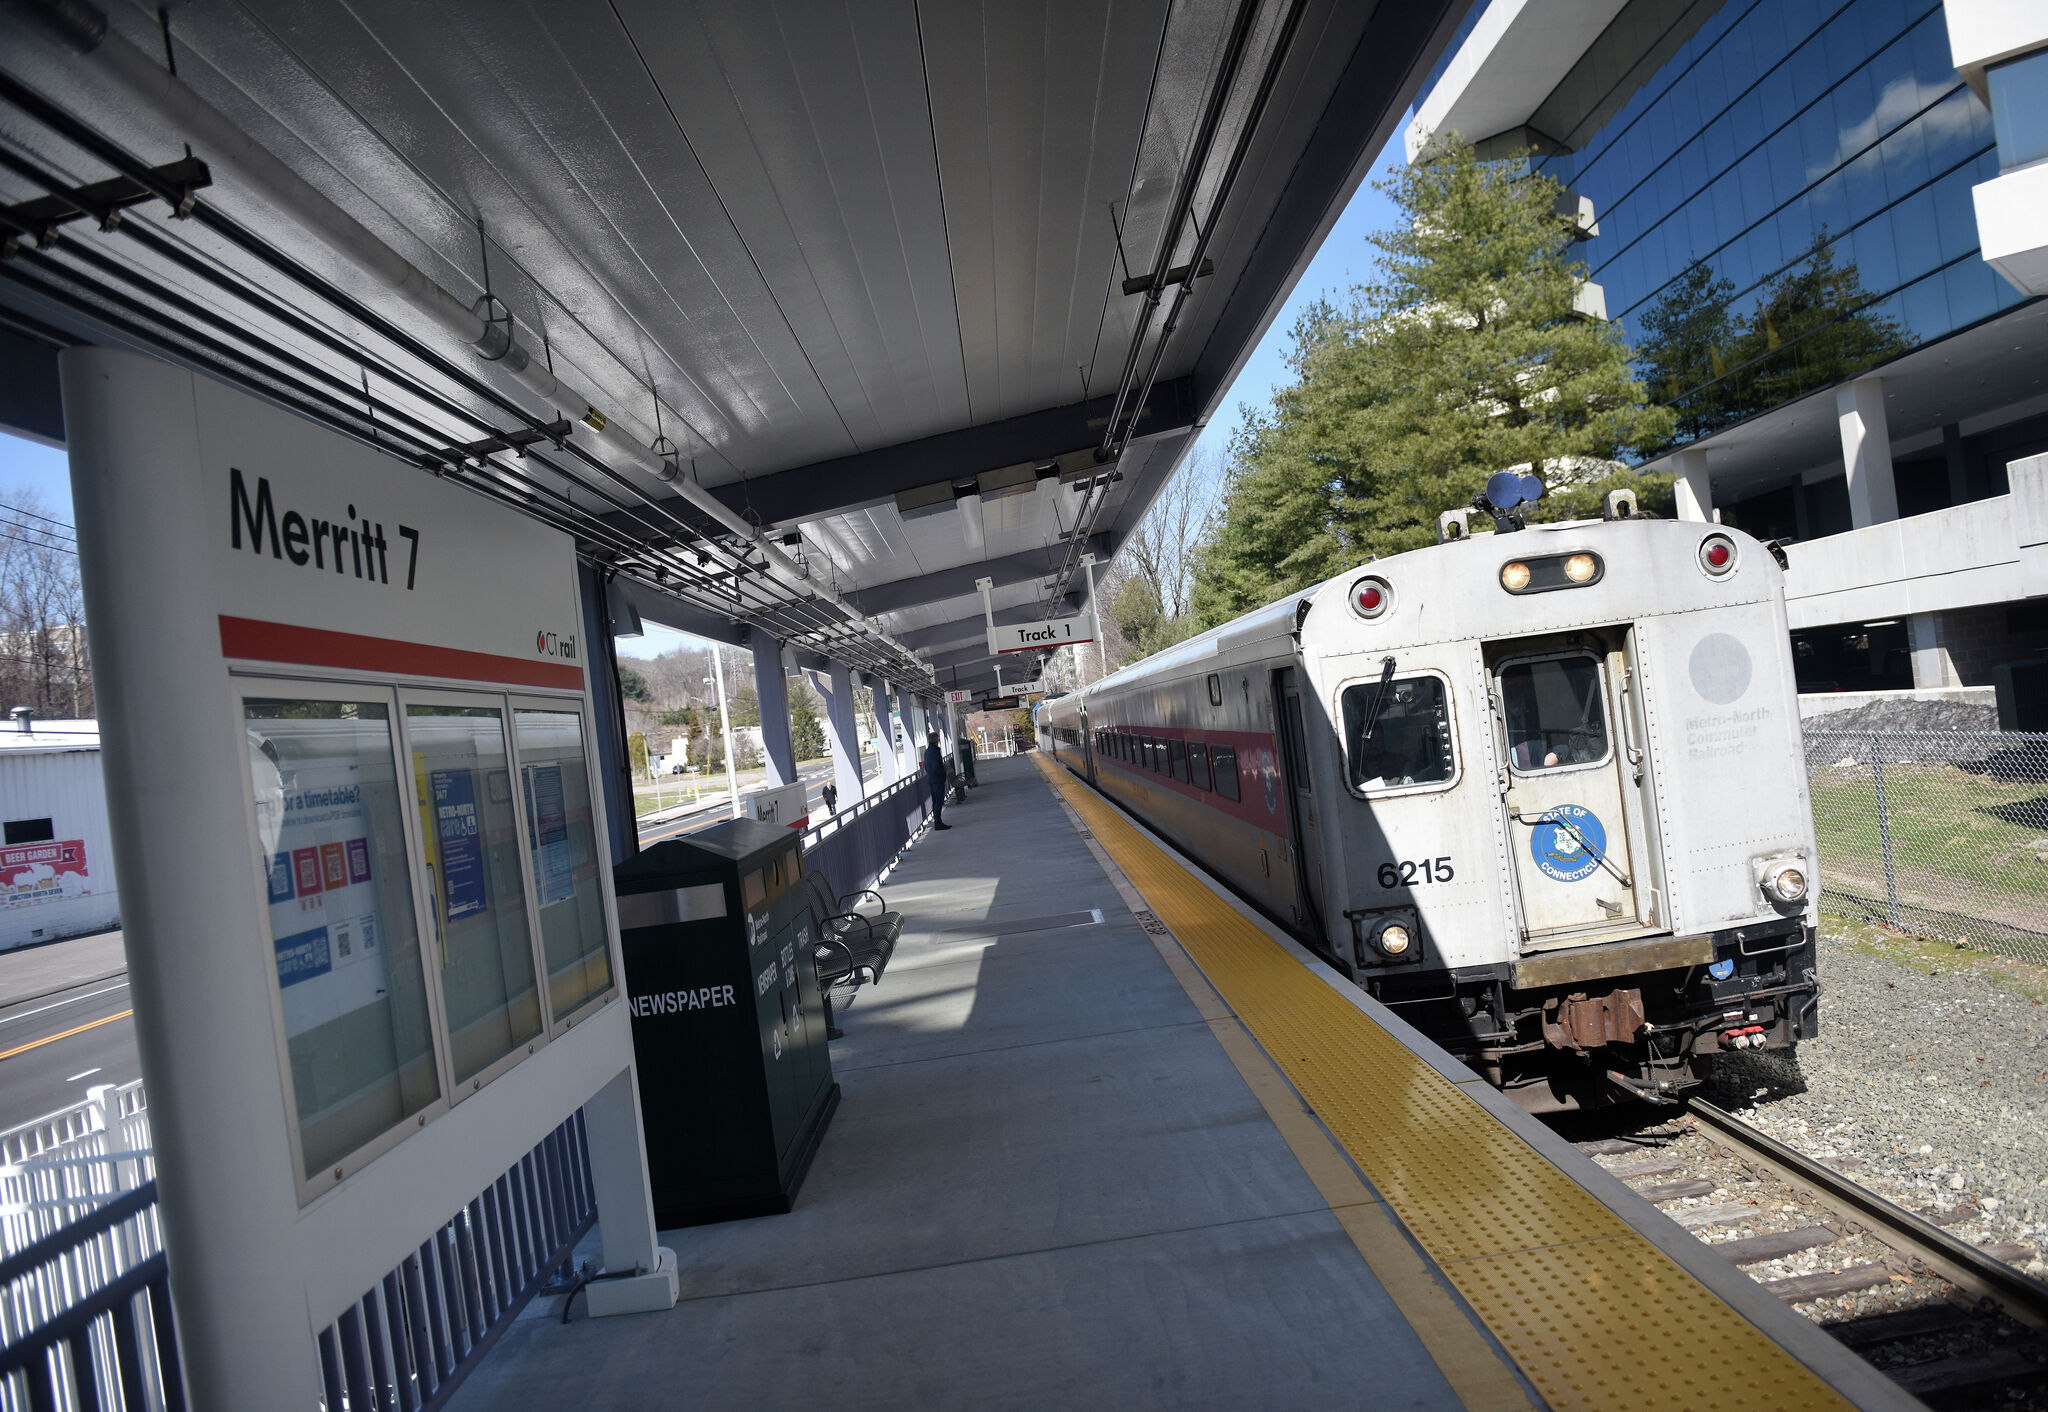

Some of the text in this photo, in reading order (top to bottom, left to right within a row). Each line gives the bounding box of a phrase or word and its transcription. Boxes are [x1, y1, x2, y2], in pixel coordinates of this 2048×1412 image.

[230, 467, 419, 590] Merritt 7
[1018, 624, 1071, 643] Track 1
[951, 692, 963, 702] EXIT
[1686, 706, 1770, 731] Metro-North
[1687, 726, 1758, 746] Commuter
[1689, 741, 1745, 761] Railroad
[296, 795, 304, 811] a
[304, 785, 360, 809] timetable?
[1543, 806, 1587, 823] STATE OF
[5, 848, 57, 864] BEER GARDEN
[1541, 853, 1600, 880] CONNECTICU
[1377, 856, 1455, 889] 6215
[797, 925, 809, 950] TRASH
[757, 961, 778, 998] NEWSPAPER
[629, 984, 737, 1018] NEWSPAPER
